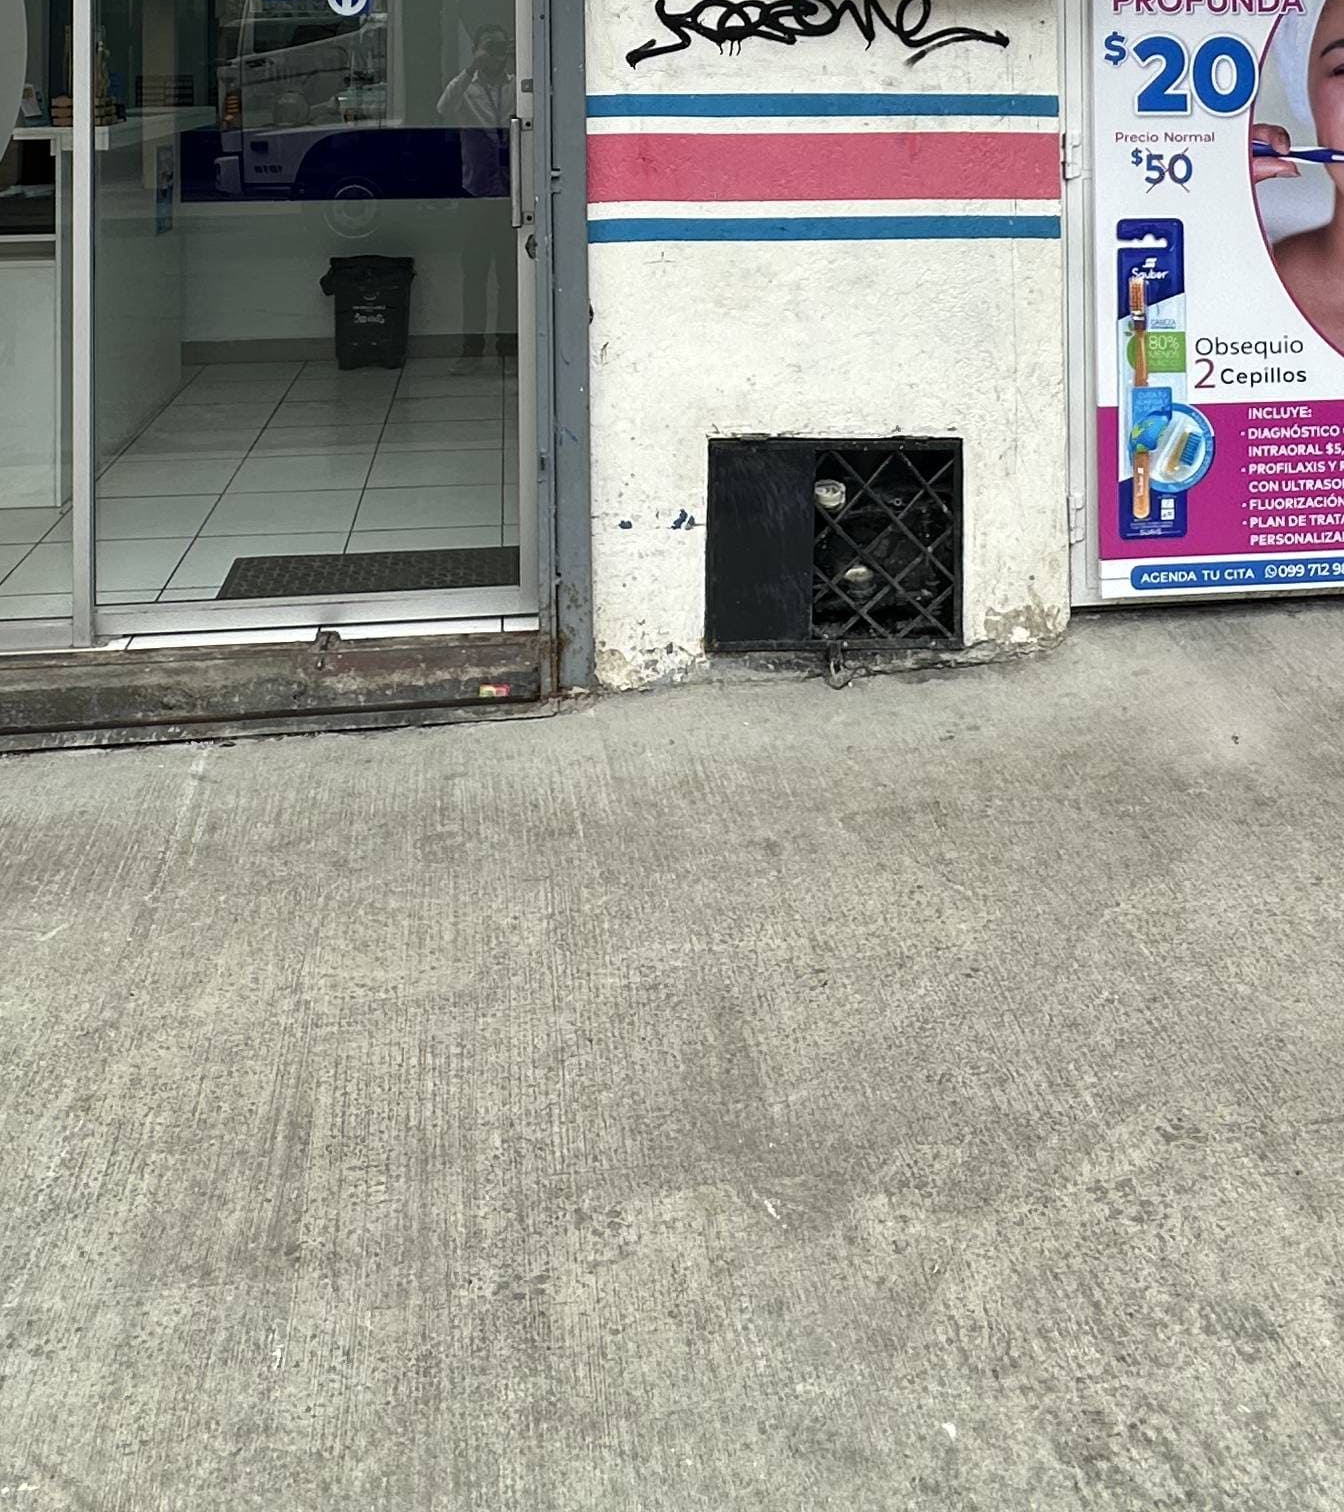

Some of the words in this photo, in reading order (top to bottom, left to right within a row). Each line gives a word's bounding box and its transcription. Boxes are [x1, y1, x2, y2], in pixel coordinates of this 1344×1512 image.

[1103, 30, 1260, 117] $20
[1115, 131, 1159, 143] Precio
[1164, 131, 1216, 143] Normal
[1194, 336, 1305, 359] Obsequio
[1194, 358, 1217, 390] 2
[1220, 368, 1307, 389] Cepillos
[1248, 406, 1313, 420] INCLUYE:
[1248, 424, 1341, 440] DIAGNÓSTICO
[1248, 443, 1324, 458] INTRAORAL
[1248, 461, 1327, 475] PROFILAXIS
[1328, 460, 1338, 473] Y
[1248, 480, 1280, 494] CON
[1249, 515, 1286, 529] PLAN
[1288, 514, 1307, 527] DE
[1140, 570, 1197, 584] AGENDA
[1202, 570, 1221, 582] TU
[1224, 568, 1255, 581] CITA
[1278, 564, 1304, 578] 099
[1307, 563, 1330, 576] 712
